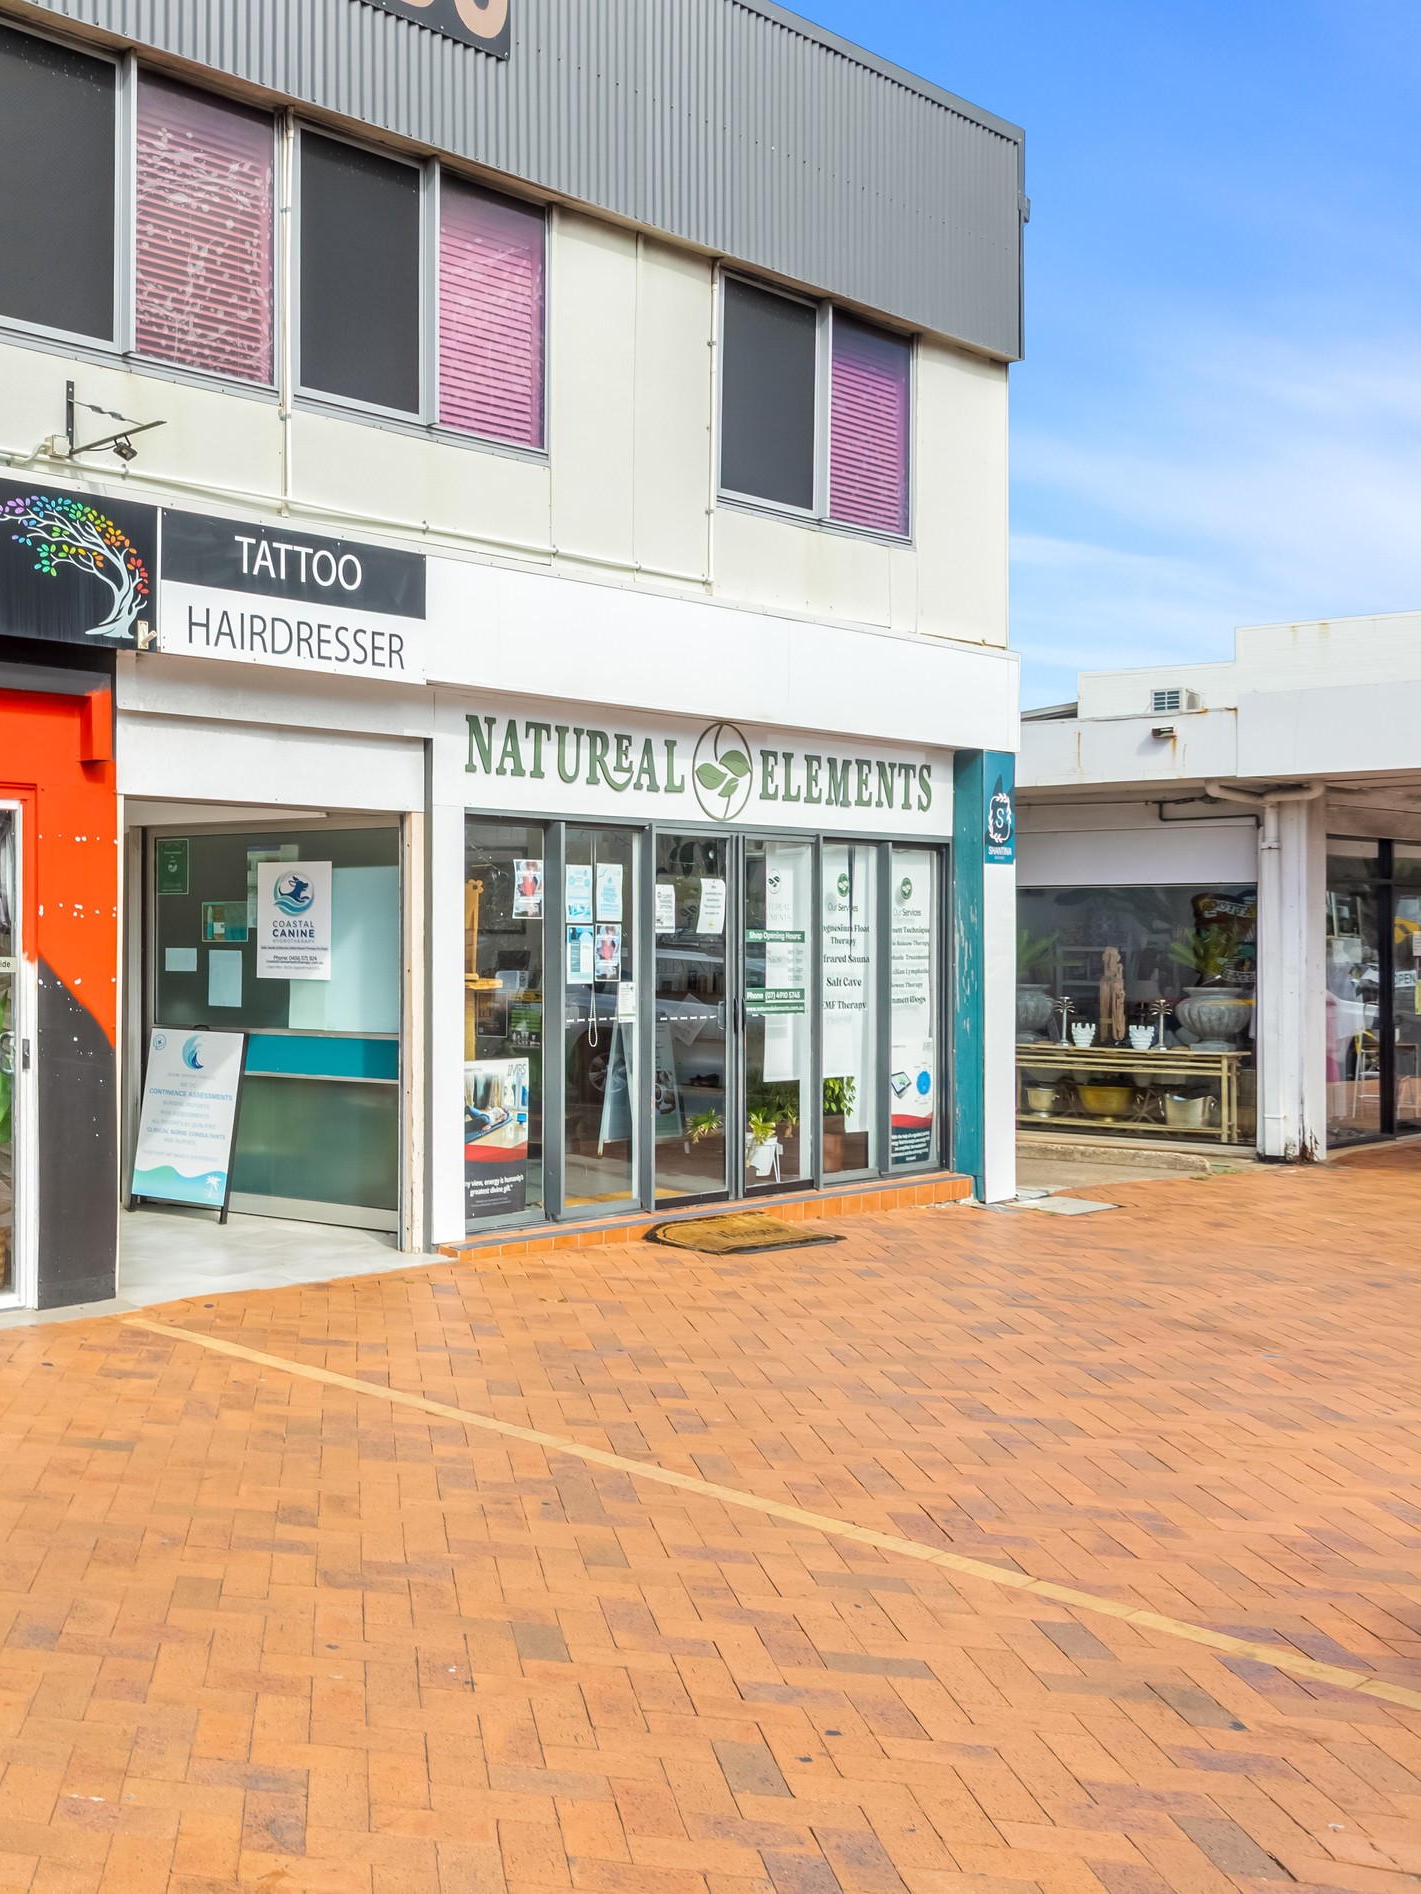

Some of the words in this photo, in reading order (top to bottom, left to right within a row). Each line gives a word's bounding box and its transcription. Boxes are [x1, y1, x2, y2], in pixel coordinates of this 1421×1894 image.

[234, 535, 362, 591] TATTOO
[188, 605, 405, 670] HAIRDRESSER
[465, 714, 685, 792] NATUREAL
[759, 749, 932, 812] ELEMENTS
[988, 846, 1012, 855] SHANTINA
[838, 903, 858, 912] Serves
[902, 908, 921, 917] Services
[272, 920, 315, 928] COASTAL
[854, 924, 869, 933] Float
[272, 929, 315, 938] CANINE
[749, 931, 762, 940] Shop
[763, 931, 785, 941] Opening
[785, 932, 802, 940] Hours:
[848, 954, 870, 963] Sauna
[826, 977, 842, 987] Salt
[843, 977, 862, 987] Cave
[765, 991, 775, 999] (07)
[837, 1000, 867, 1011] Therapy
[149, 1088, 187, 1097] CONTINENCE
[188, 1091, 233, 1102] ASSESSMENTS
[470, 1187, 490, 1198] greatest
[490, 1186, 503, 1194] divine
